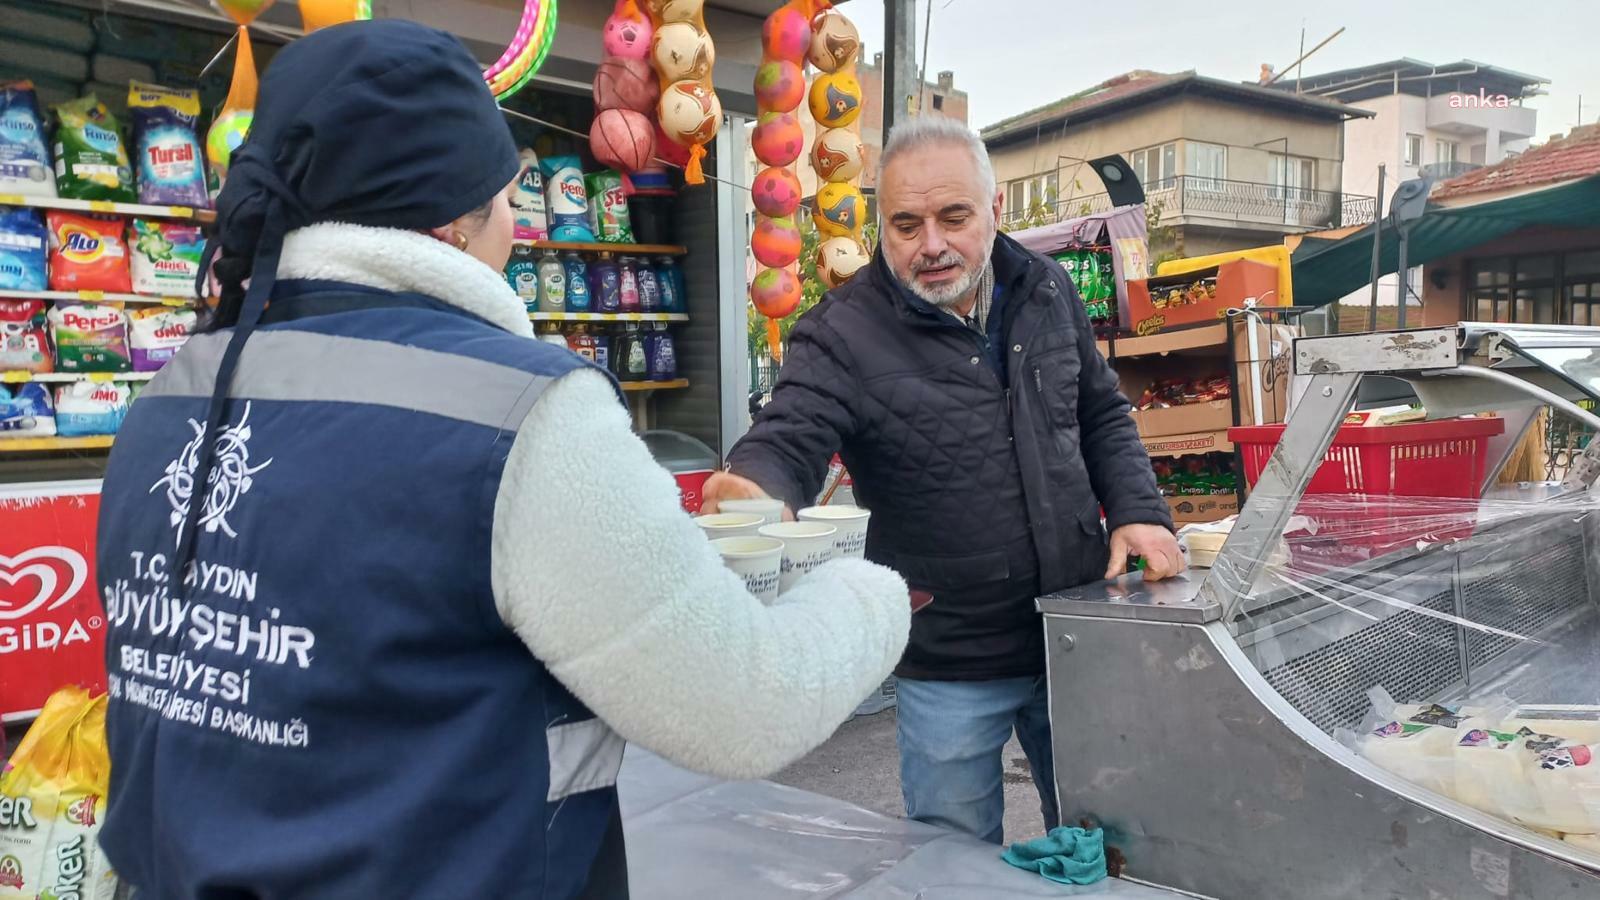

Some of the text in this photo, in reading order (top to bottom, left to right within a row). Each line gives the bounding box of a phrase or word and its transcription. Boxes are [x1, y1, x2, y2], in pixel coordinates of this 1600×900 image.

[148, 143, 193, 165] Tursil
[63, 312, 119, 330] Persil
[130, 550, 170, 583] T.C.
